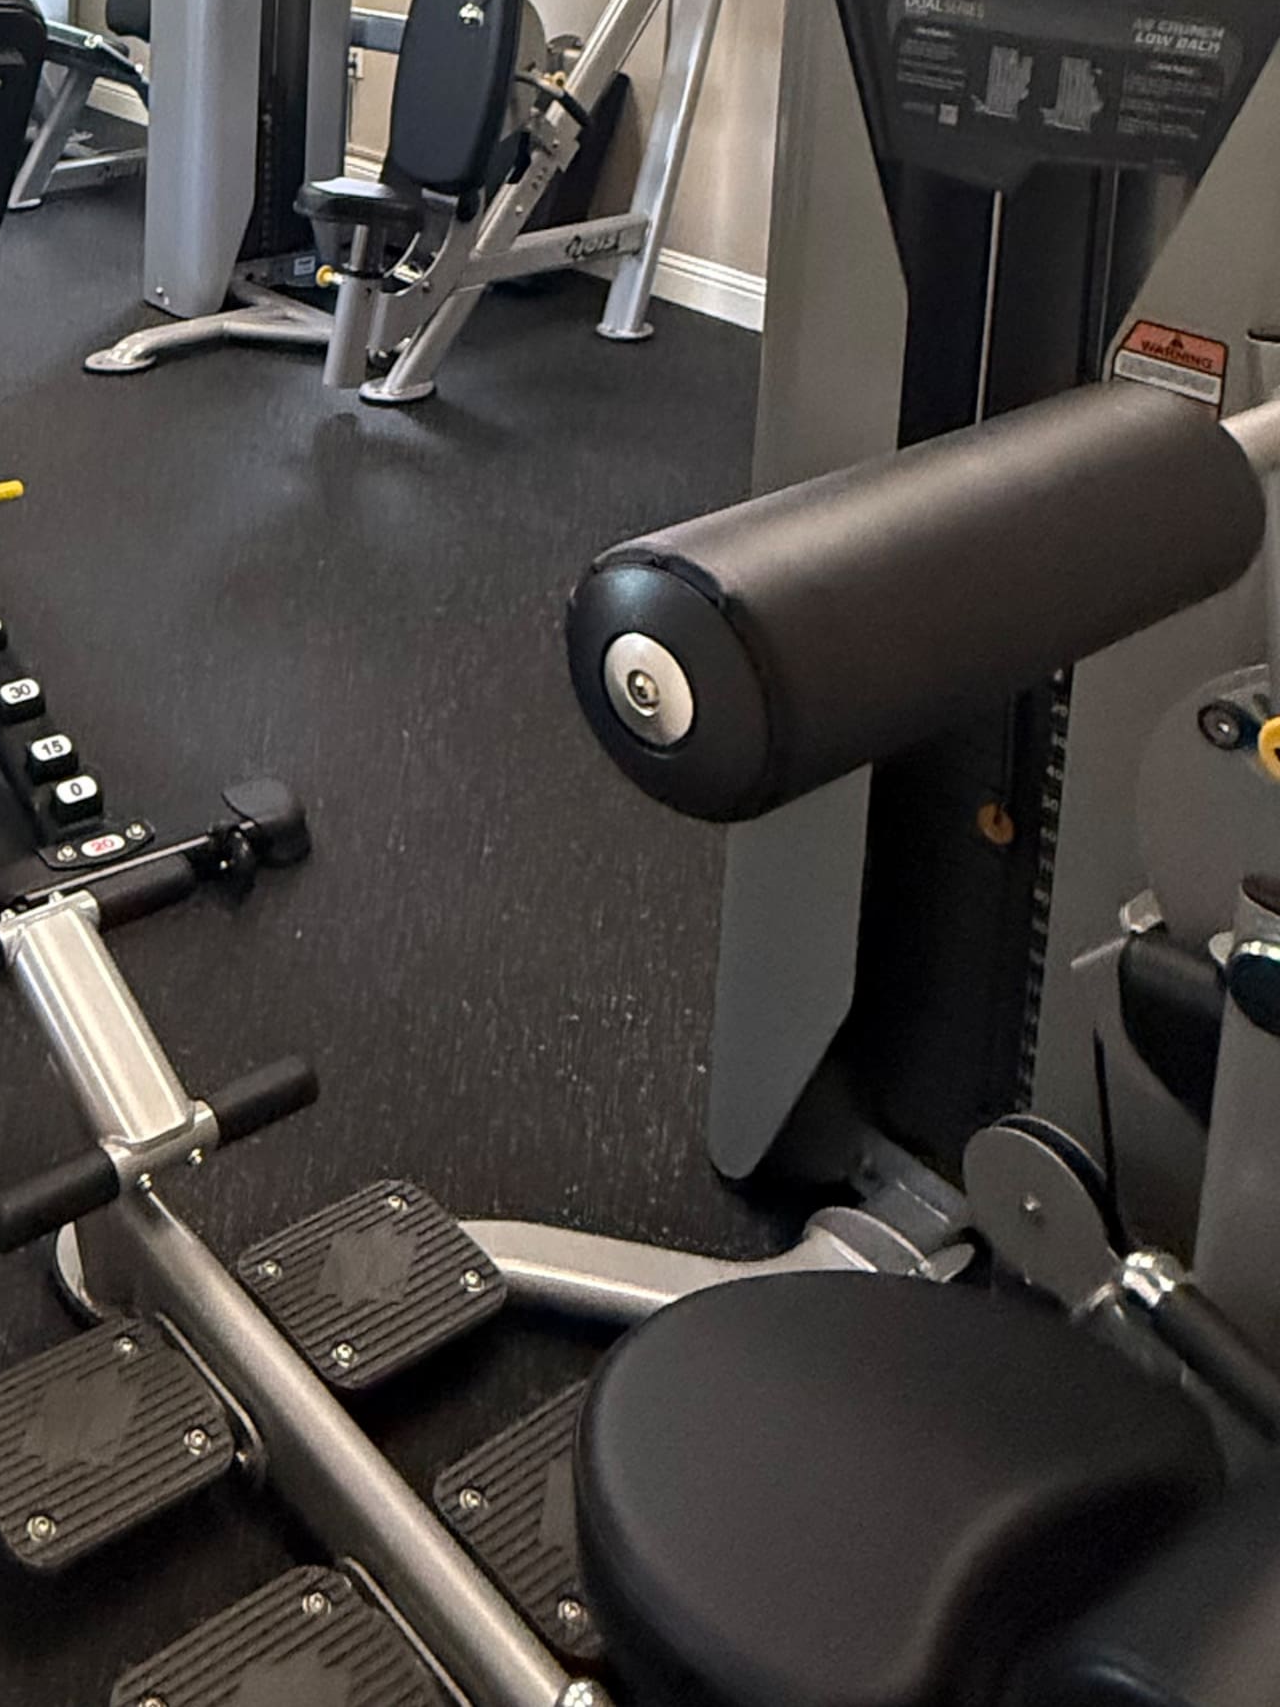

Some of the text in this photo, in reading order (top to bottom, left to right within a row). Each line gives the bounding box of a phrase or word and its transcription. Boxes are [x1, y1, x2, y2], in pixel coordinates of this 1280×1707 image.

[1135, 31, 1174, 46] LOW
[1140, 339, 1215, 370] WARNING
[9, 683, 32, 699] 30
[41, 740, 63, 756] 15
[70, 782, 83, 796] 0
[91, 837, 115, 852] 20
